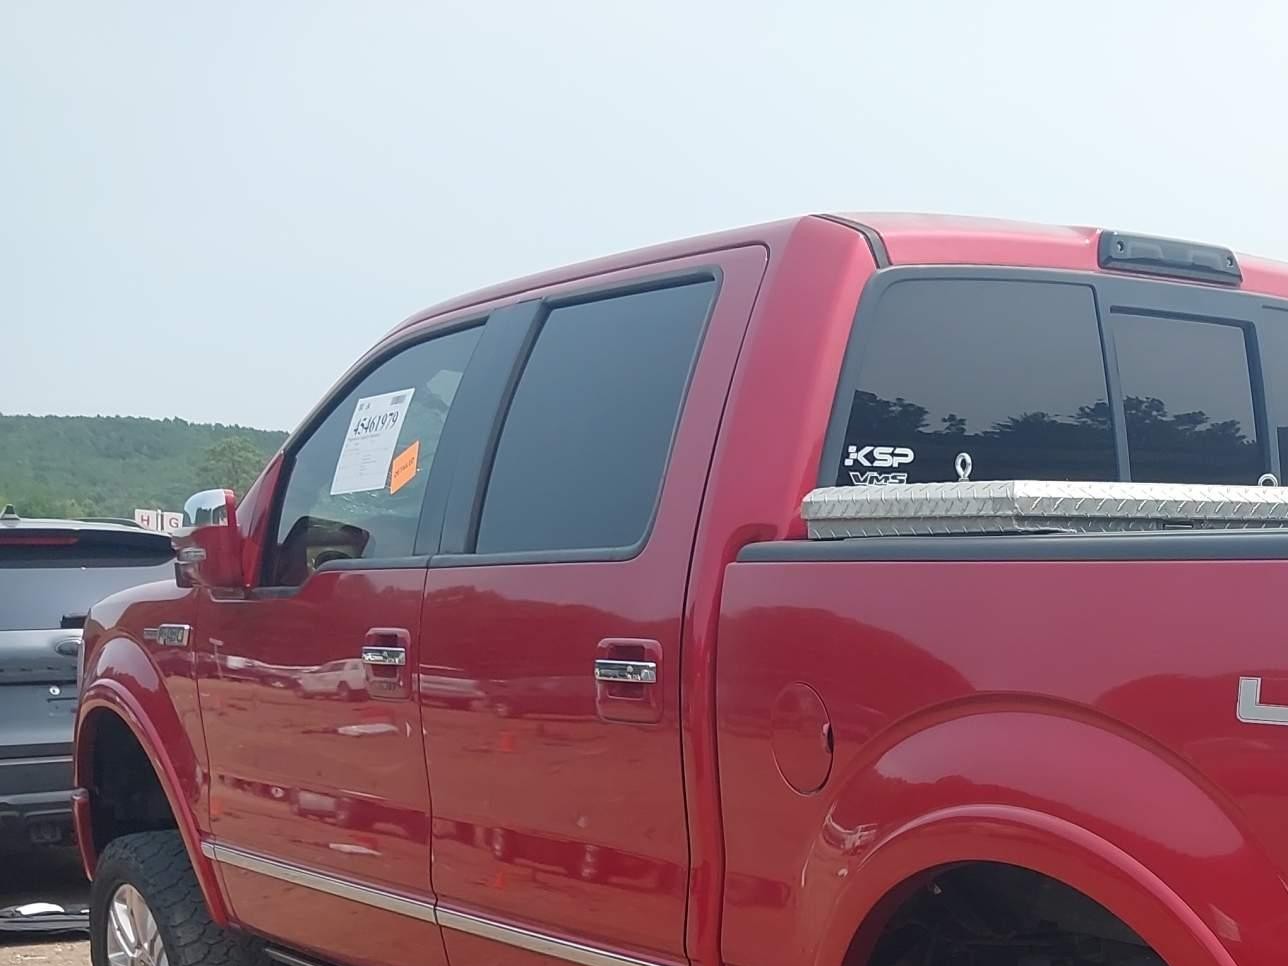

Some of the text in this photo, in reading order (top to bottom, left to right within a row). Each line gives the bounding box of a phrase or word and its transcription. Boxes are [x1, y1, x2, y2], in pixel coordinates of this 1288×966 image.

[353, 410, 399, 436] 45461979
[844, 445, 915, 467] KSP
[849, 471, 908, 486] VMS
[140, 514, 150, 526] H
[168, 517, 179, 528] G
